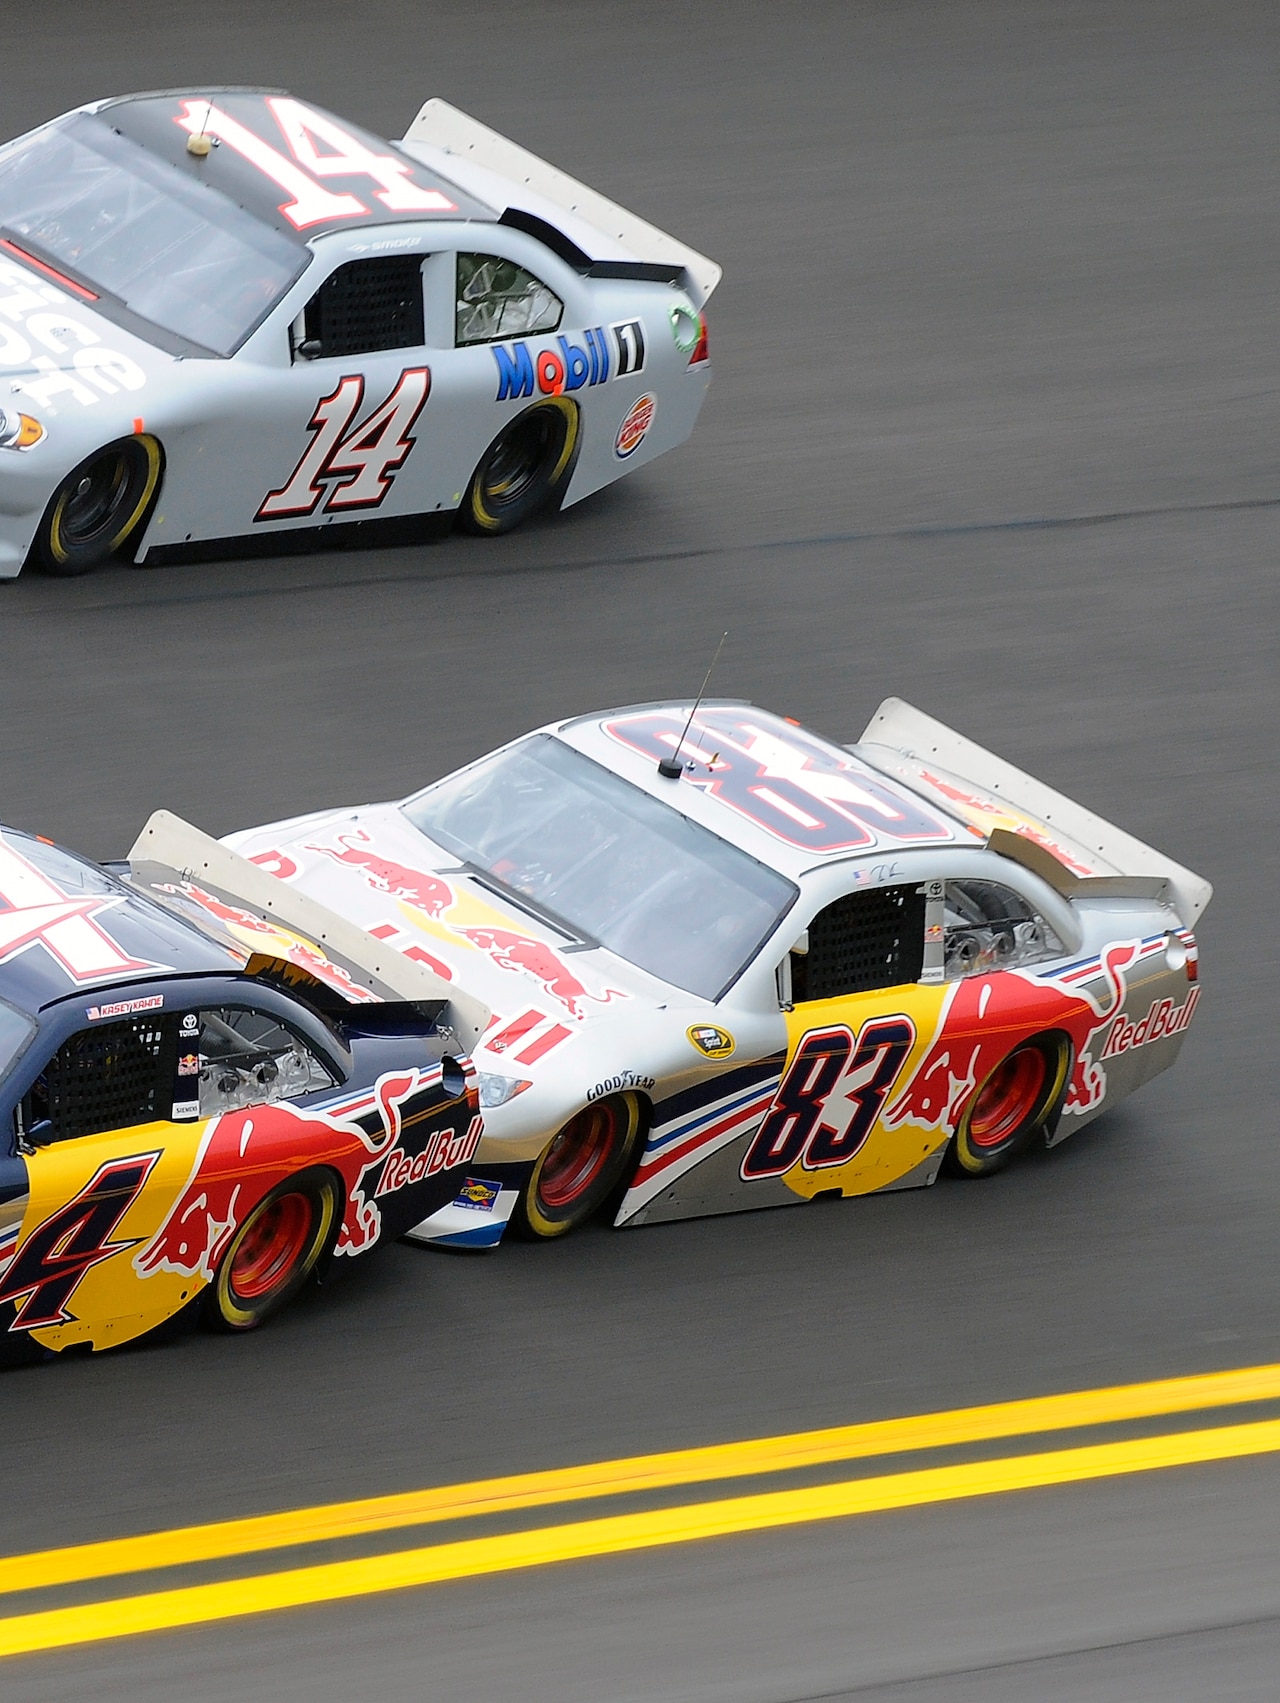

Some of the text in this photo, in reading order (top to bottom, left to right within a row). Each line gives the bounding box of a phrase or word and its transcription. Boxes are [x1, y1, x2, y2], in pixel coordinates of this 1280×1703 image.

[172, 96, 458, 231] 14
[491, 327, 610, 402] Mobil
[253, 366, 431, 523] 14
[599, 706, 954, 855] 83
[102, 996, 162, 1015] KASEY KAHNE
[1099, 985, 1201, 1060] Red Bull
[586, 1070, 656, 1102] GOODYEAR
[739, 1013, 916, 1182] 83
[375, 1115, 484, 1197] Red Bull
